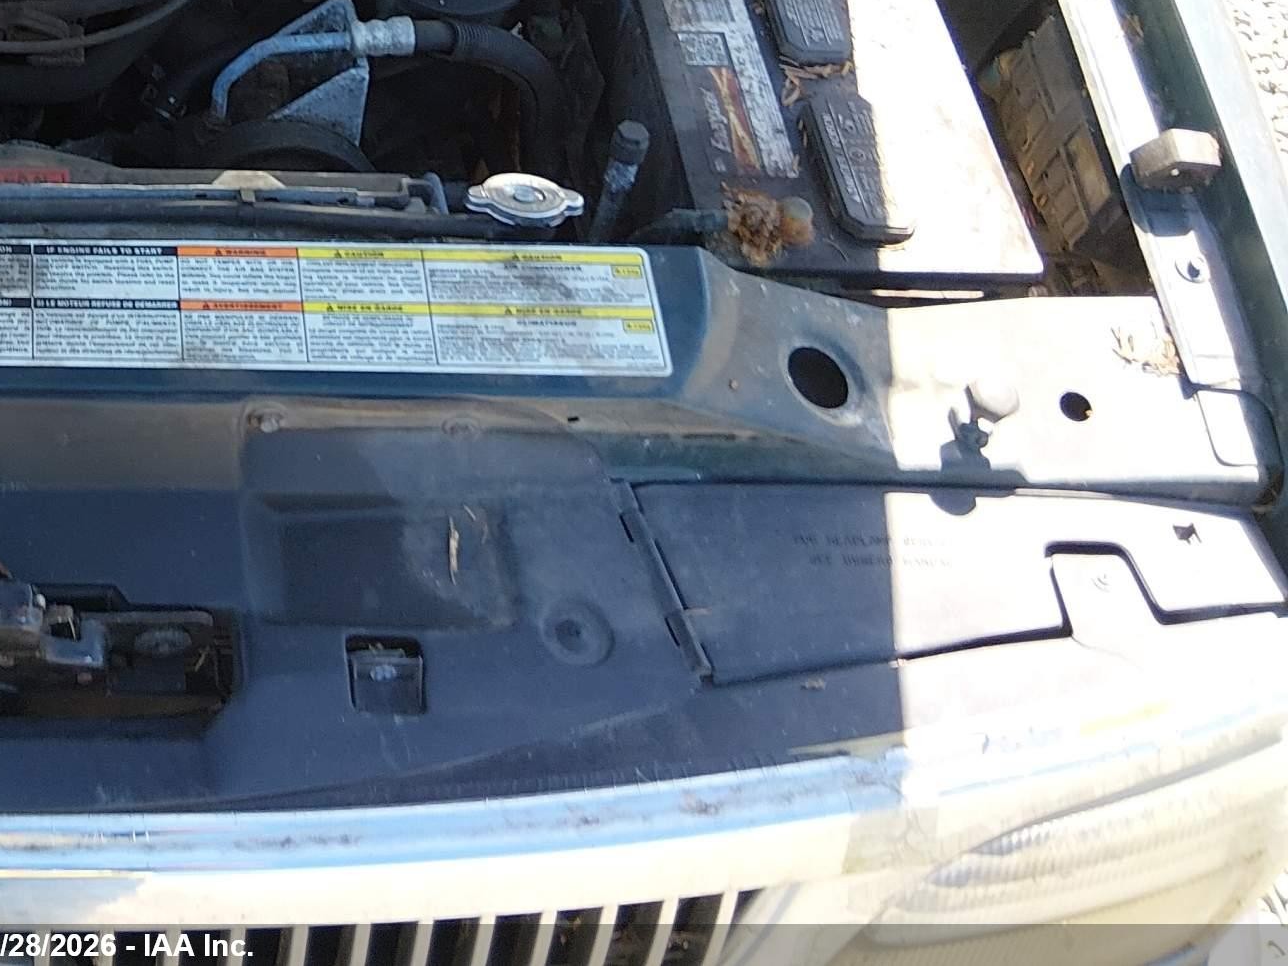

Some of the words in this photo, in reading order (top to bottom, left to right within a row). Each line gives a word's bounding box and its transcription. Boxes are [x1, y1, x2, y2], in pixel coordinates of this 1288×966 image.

[46, 246, 55, 254] IF
[57, 246, 90, 254] ENGINE
[92, 247, 118, 255] FAILS
[120, 247, 132, 255] TO
[56, 300, 90, 308] MOTEUR
